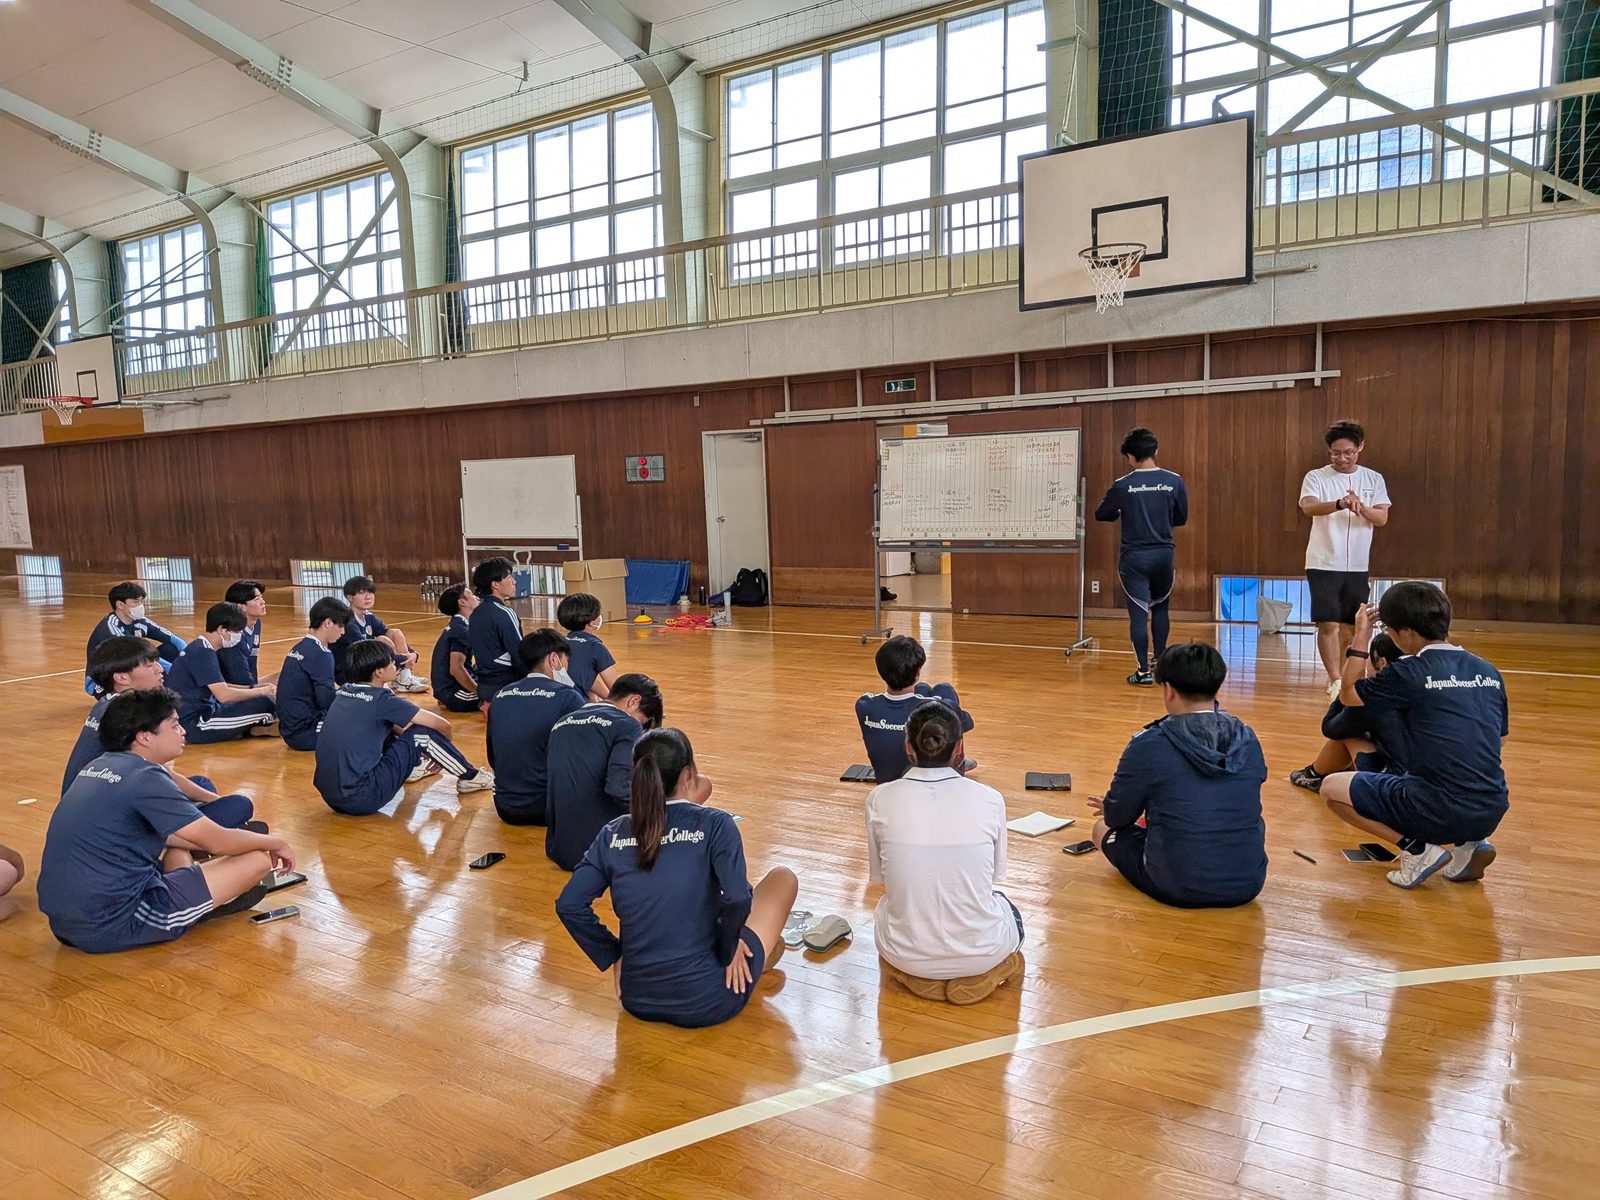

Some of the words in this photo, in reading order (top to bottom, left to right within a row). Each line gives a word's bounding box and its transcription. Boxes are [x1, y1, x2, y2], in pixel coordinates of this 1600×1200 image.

[1127, 483, 1174, 493] JapanSoccerCollege
[864, 715, 907, 731] JapanSoccer
[609, 827, 705, 850] JapanerCollege
